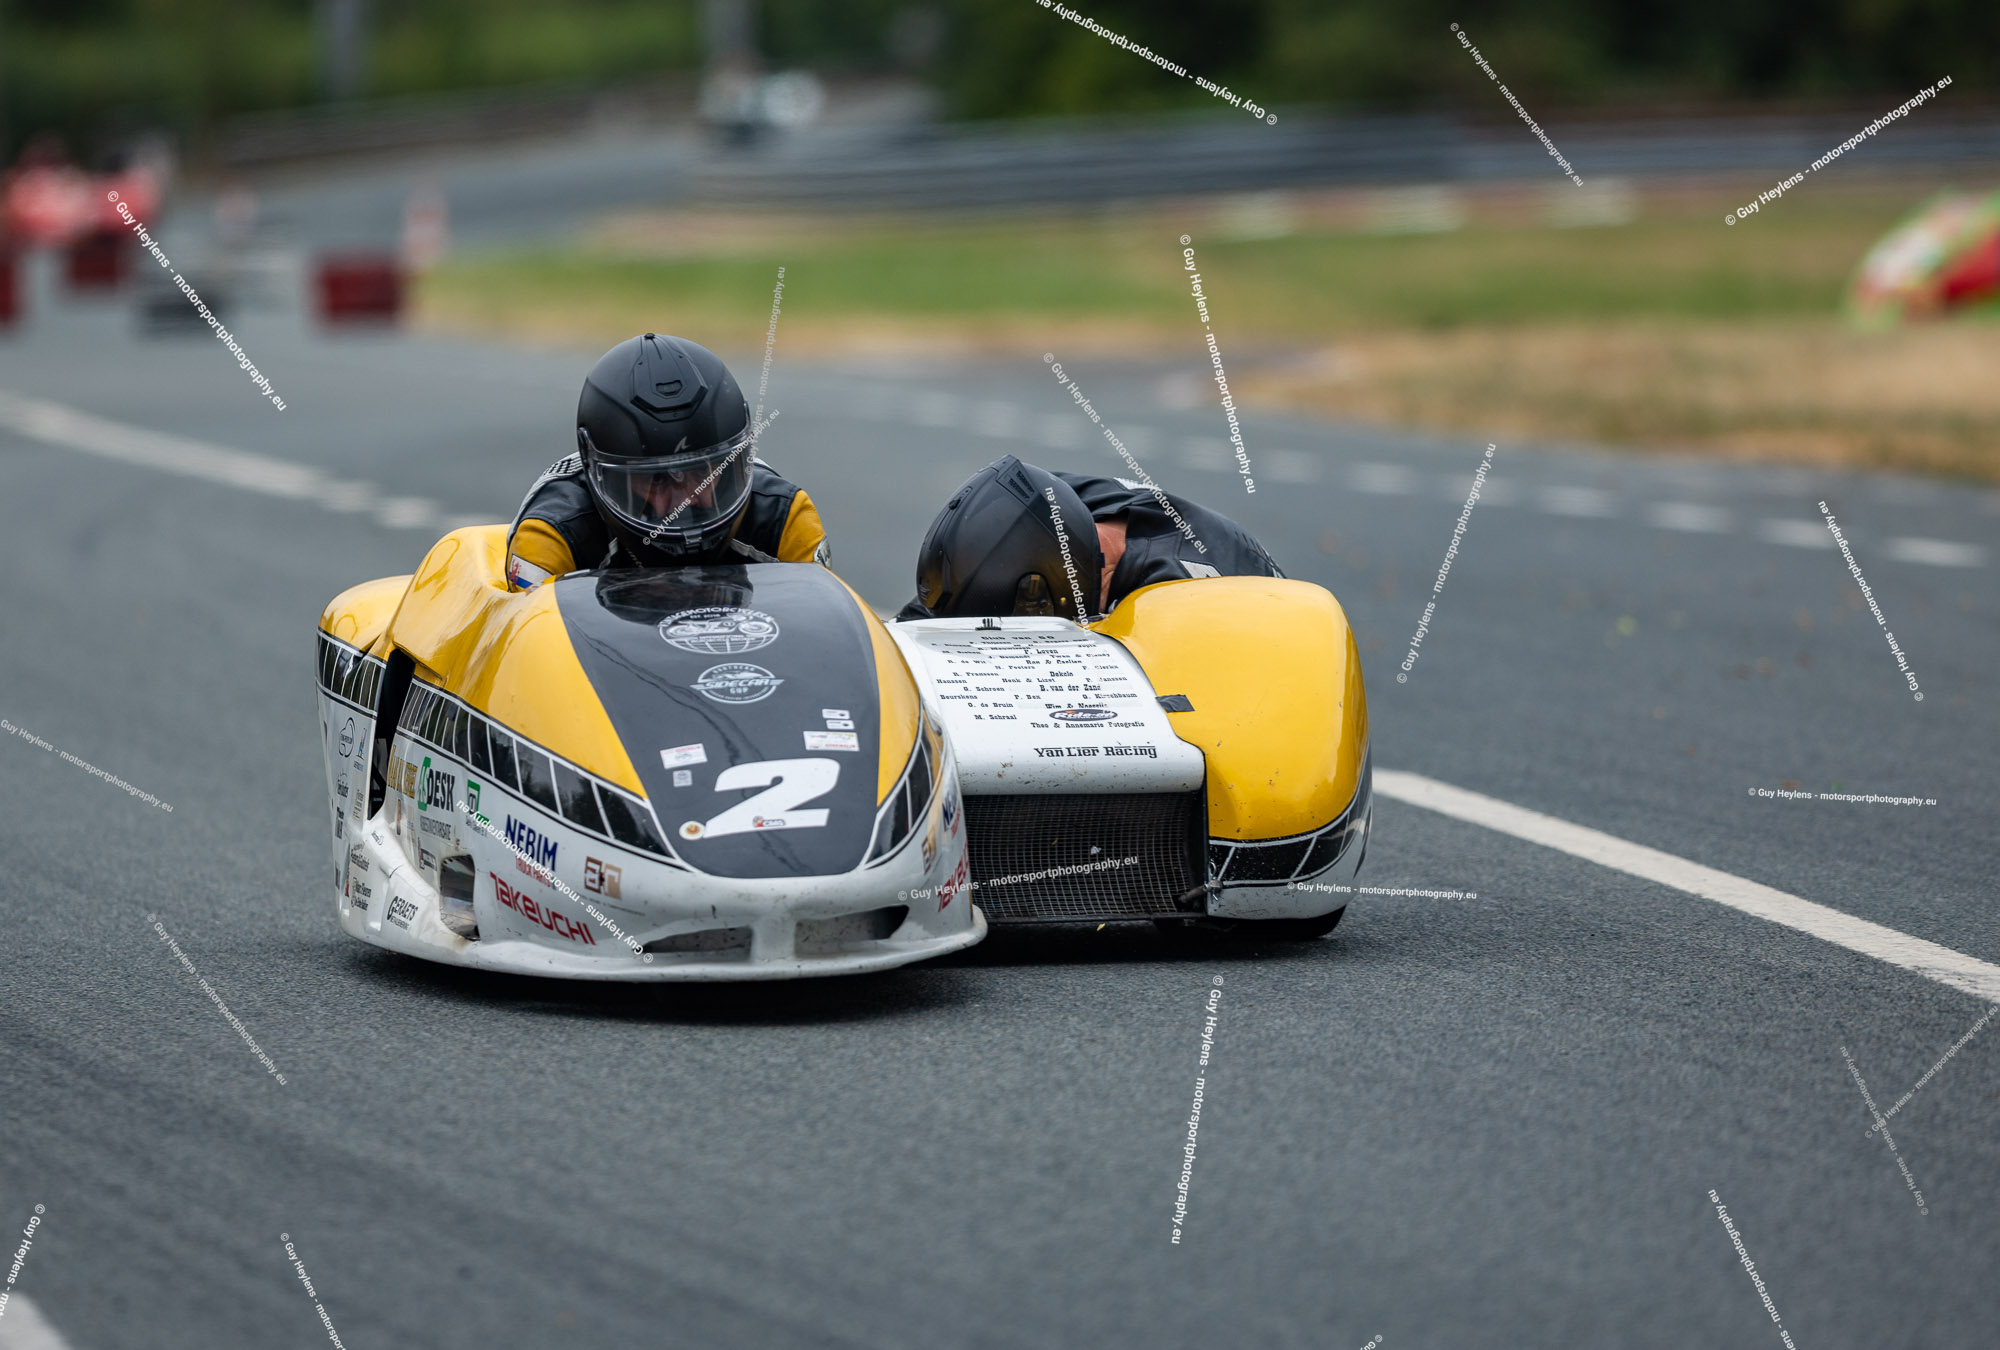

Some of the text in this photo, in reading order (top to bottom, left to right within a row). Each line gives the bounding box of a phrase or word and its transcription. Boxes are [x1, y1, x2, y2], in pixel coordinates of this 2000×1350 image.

[705, 679, 770, 690] SIDECAR
[1102, 745, 1158, 759] Racing
[702, 757, 841, 839] 2
[505, 813, 559, 872] NEBIM
